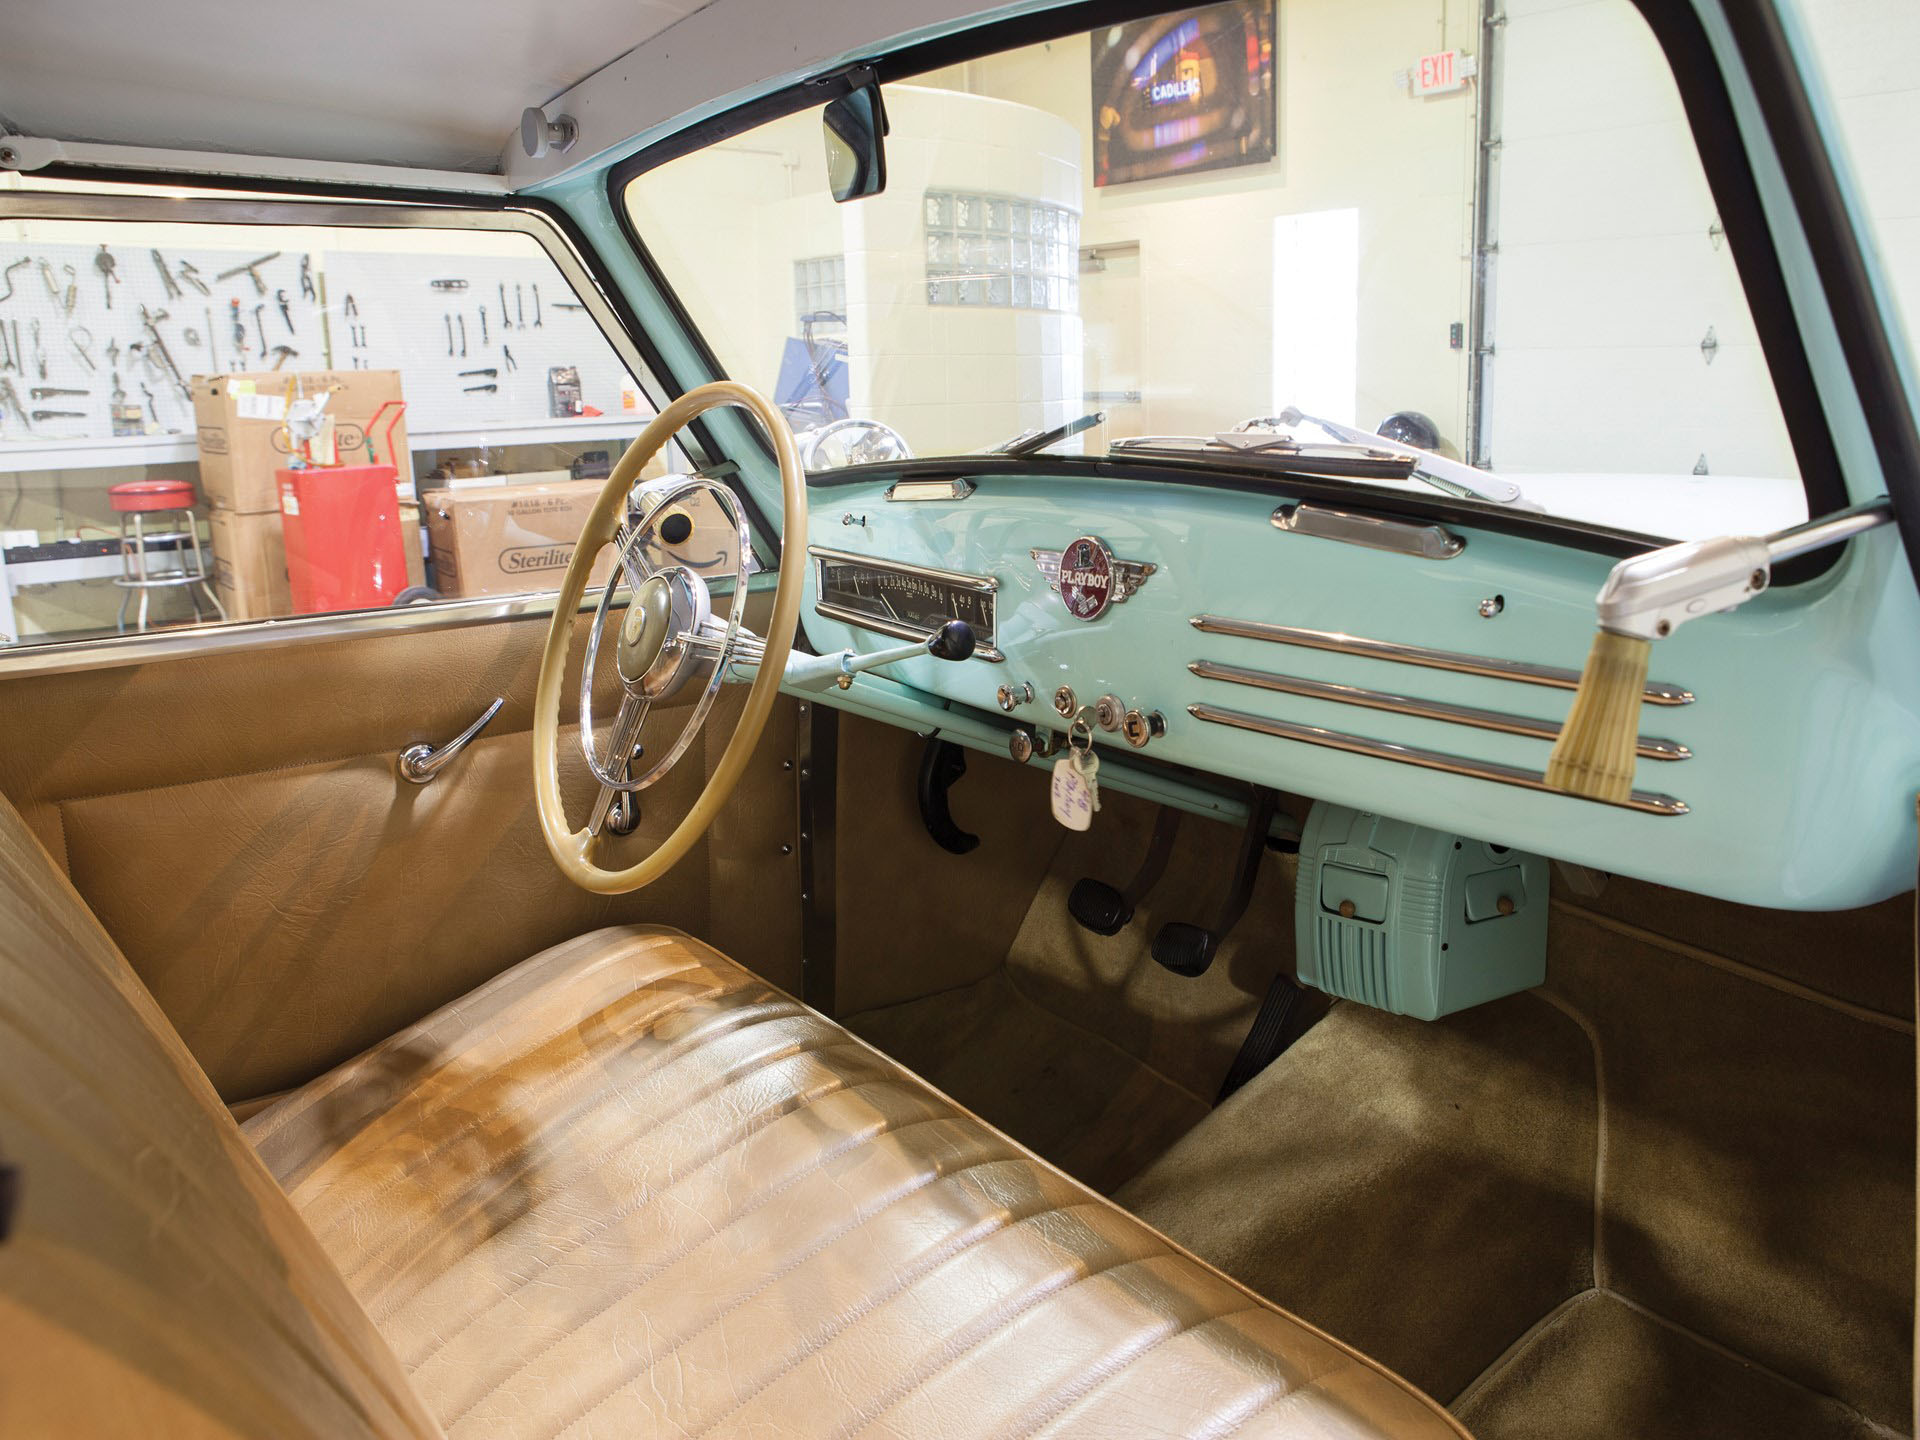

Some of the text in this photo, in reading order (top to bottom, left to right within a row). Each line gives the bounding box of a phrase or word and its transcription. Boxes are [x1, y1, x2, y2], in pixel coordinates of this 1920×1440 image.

[1421, 52, 1454, 88] EXIT
[1152, 78, 1200, 101] CADILLAC
[1062, 569, 1109, 589] PLAYBOY
